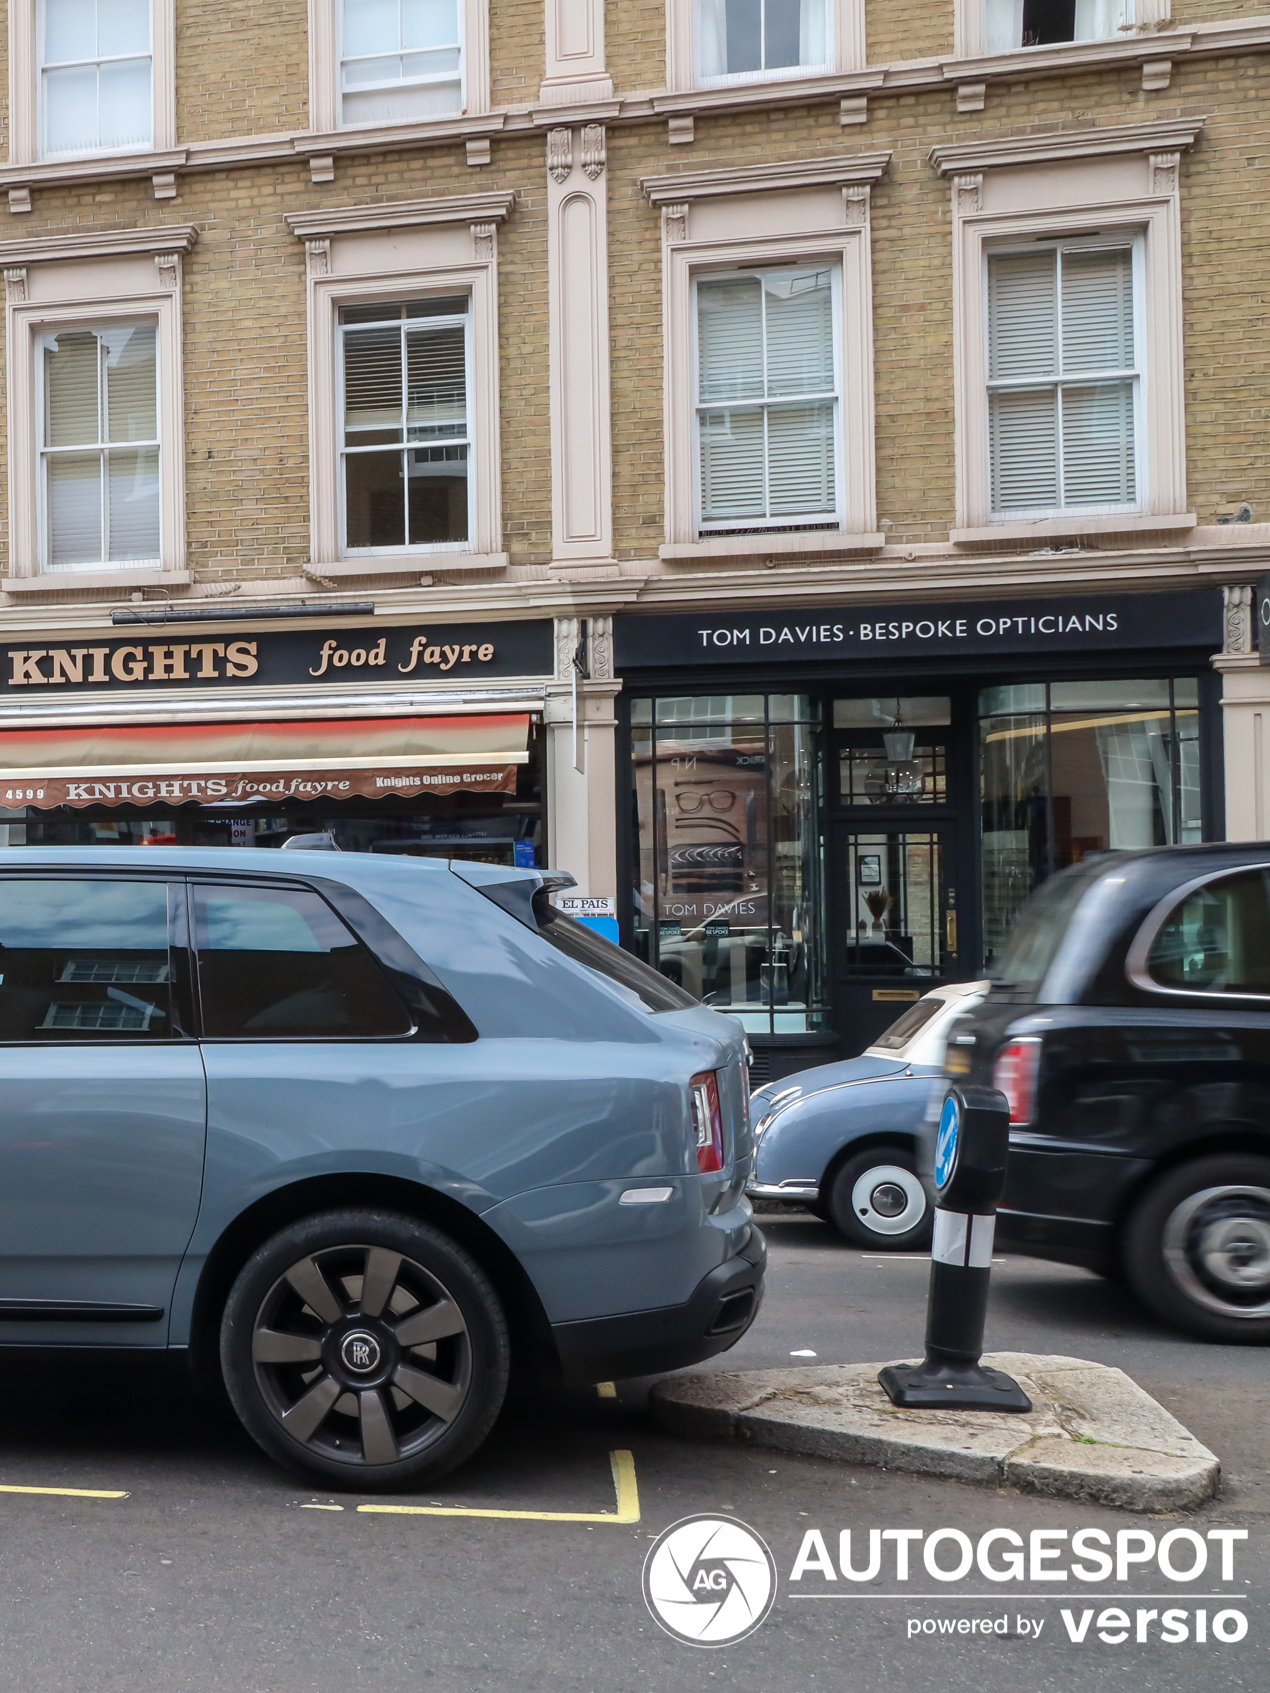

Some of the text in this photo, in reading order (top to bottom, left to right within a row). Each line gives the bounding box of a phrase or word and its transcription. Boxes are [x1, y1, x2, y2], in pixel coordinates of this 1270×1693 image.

[698, 613, 1118, 647] TOM DAVIES BESPOKE OPTICIANS
[8, 635, 495, 685] KNIGHTS food fayre
[375, 772, 504, 788] Knights Online Grocer
[5, 788, 45, 800] 4599
[65, 777, 351, 800] KNIGHTS food fayre
[562, 899, 609, 909] EL PAIS
[663, 902, 756, 916] TOM DAVIES
